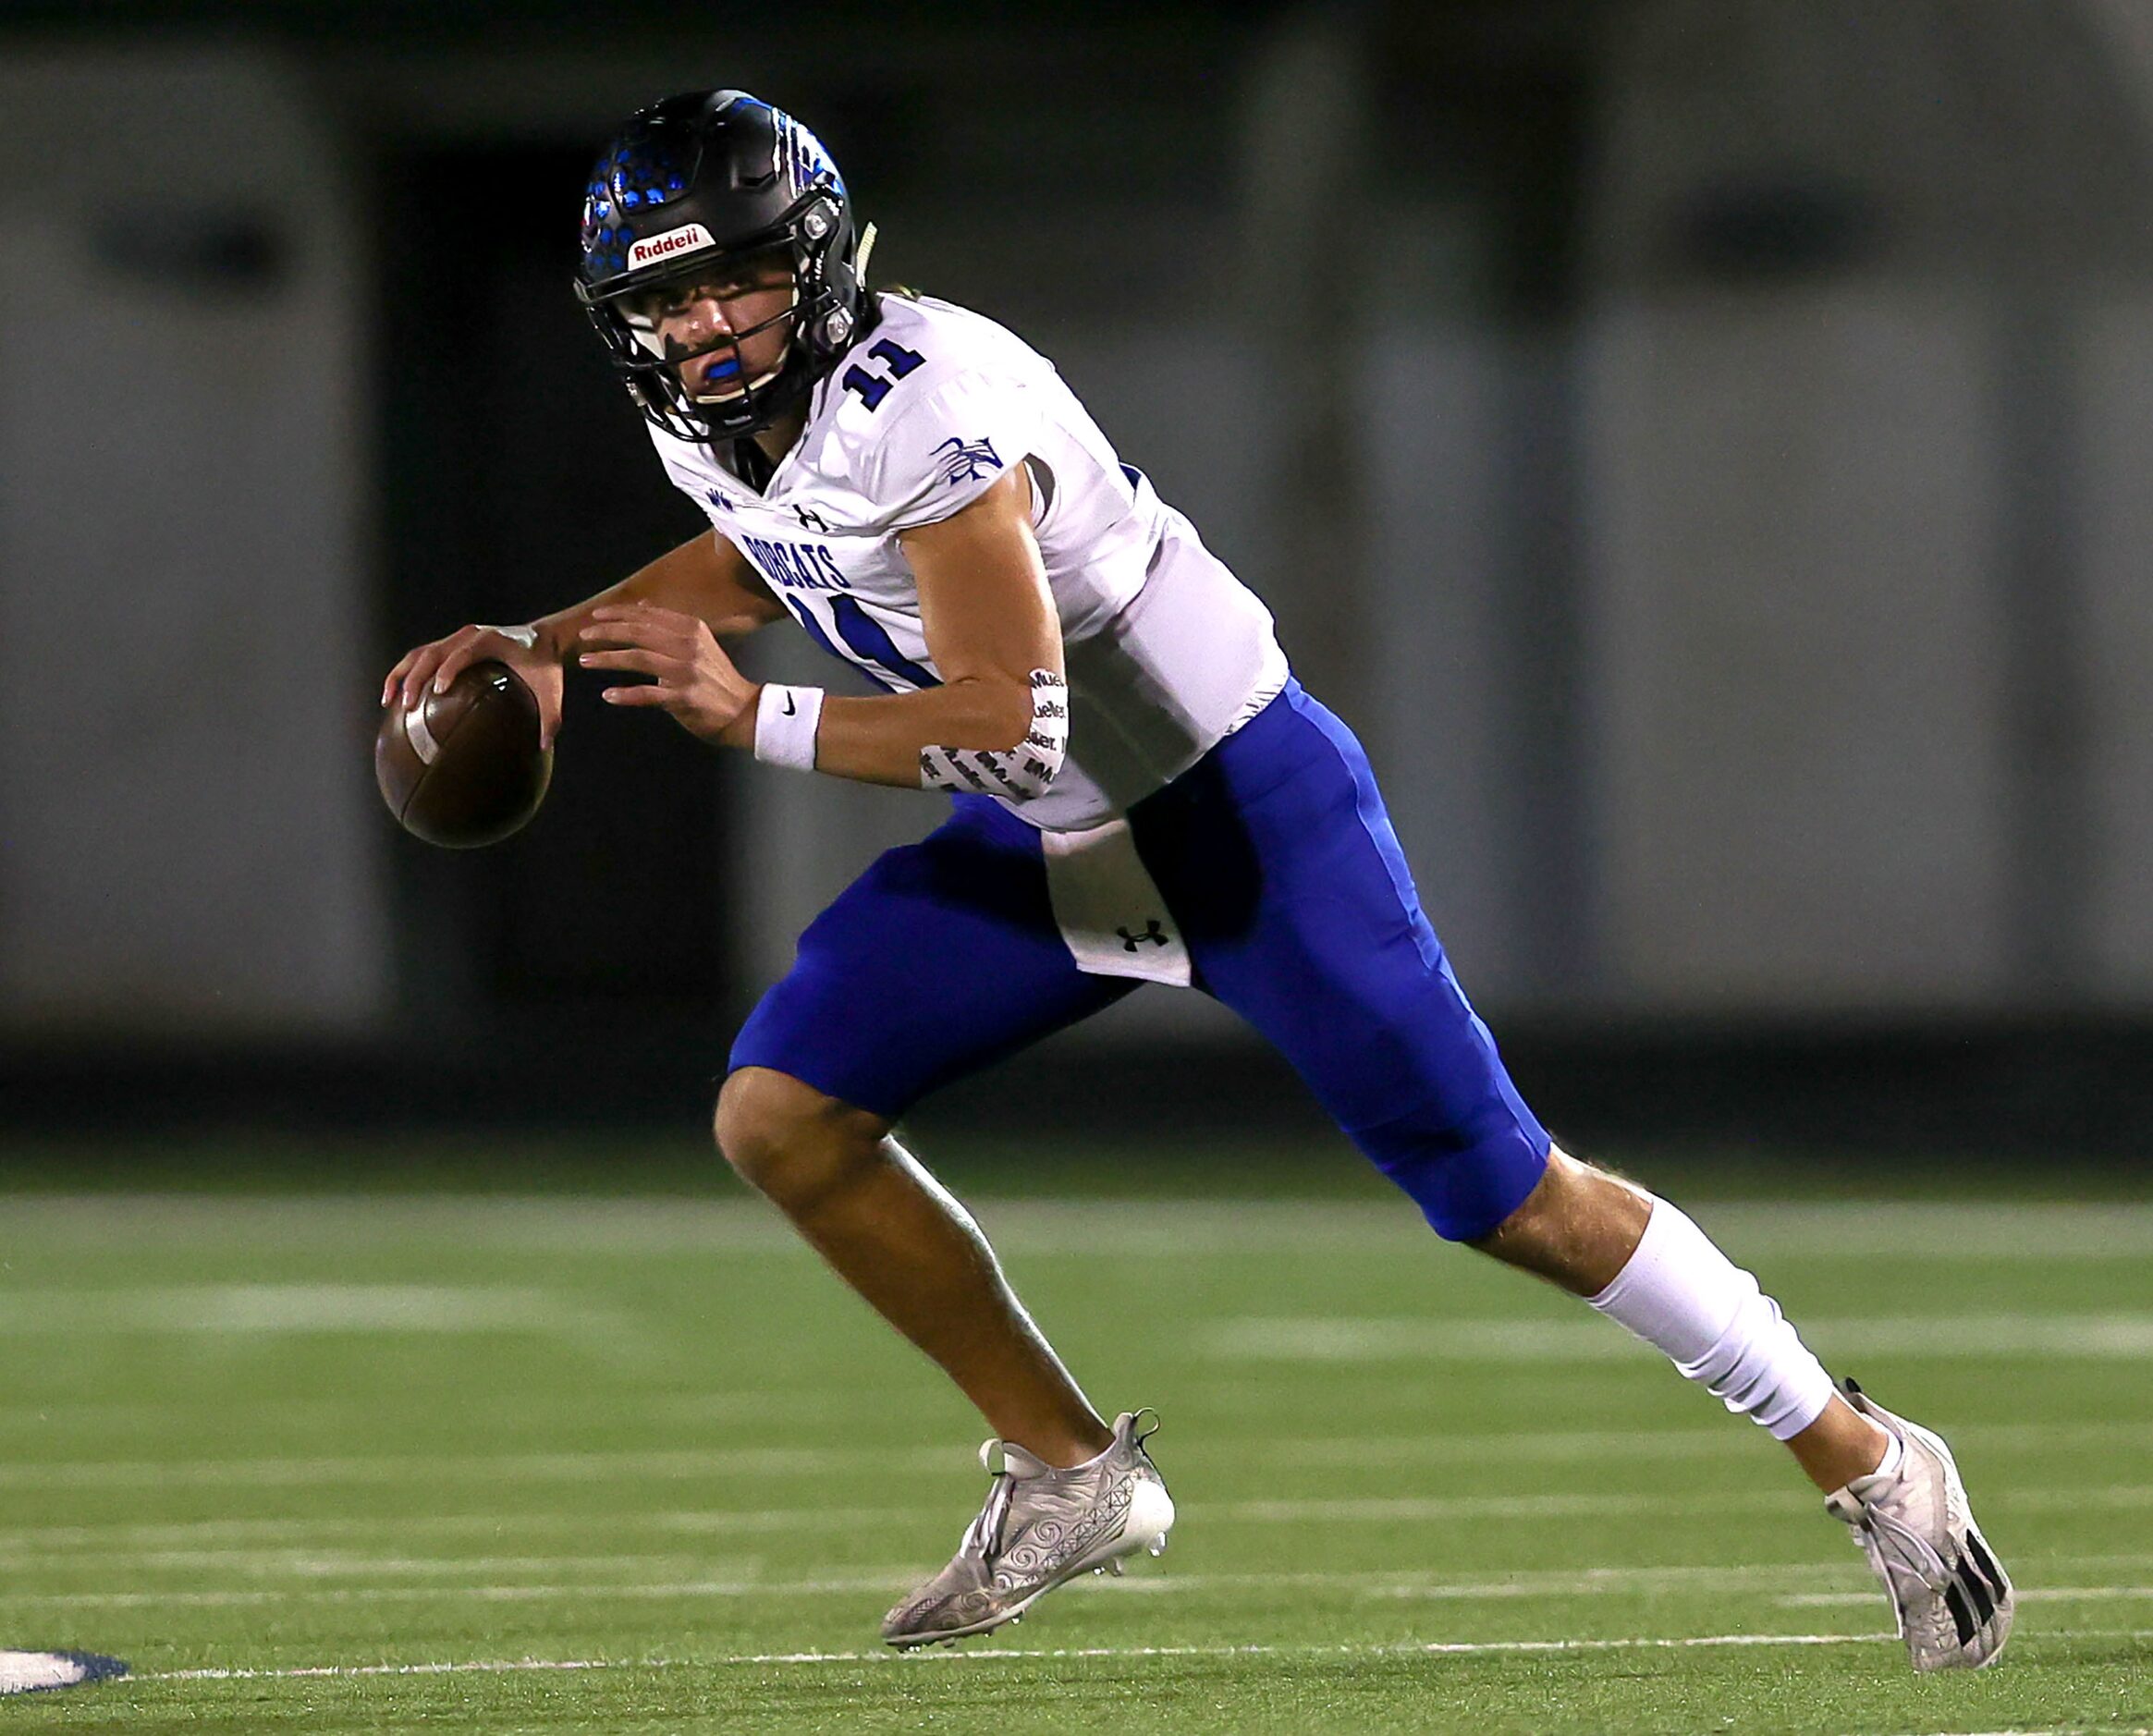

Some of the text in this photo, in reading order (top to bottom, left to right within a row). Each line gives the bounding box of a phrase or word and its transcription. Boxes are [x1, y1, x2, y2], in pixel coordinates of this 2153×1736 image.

[634, 227, 699, 261] Riddell
[842, 337, 926, 413] 11
[741, 534, 851, 589] BOBCATS
